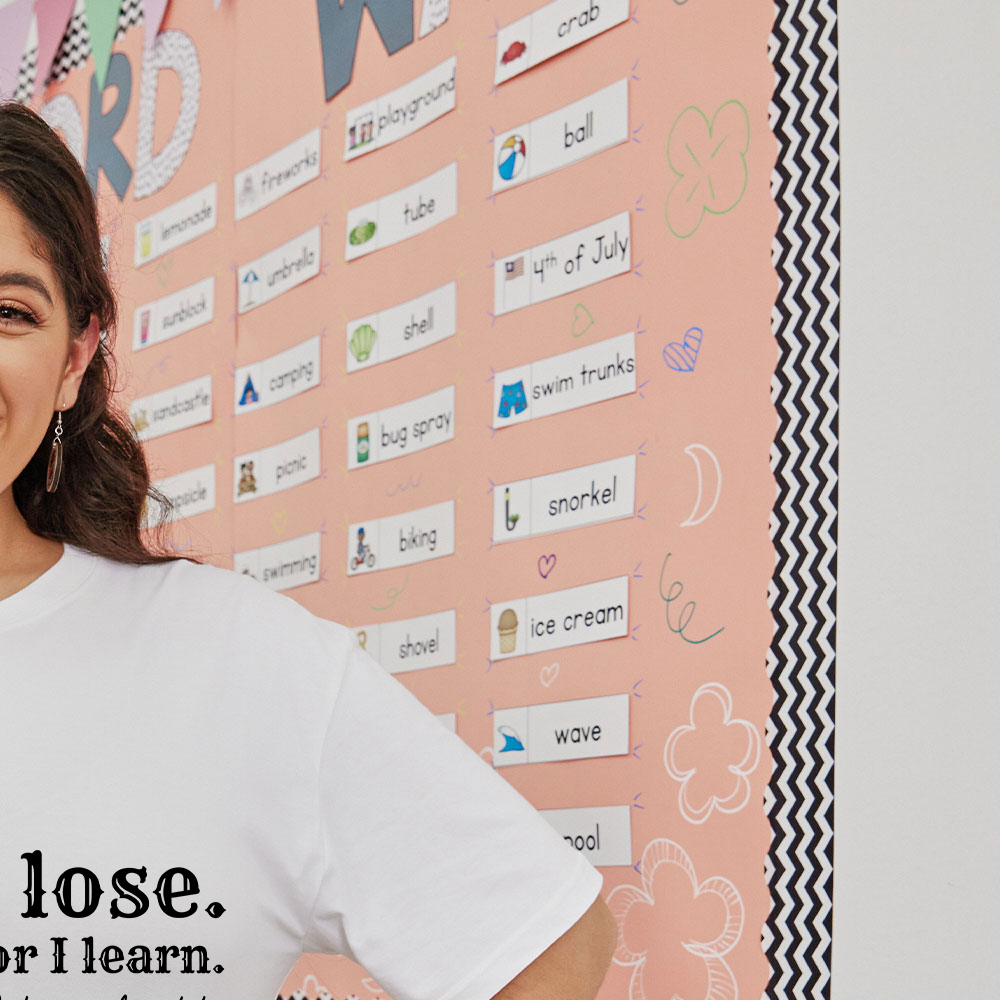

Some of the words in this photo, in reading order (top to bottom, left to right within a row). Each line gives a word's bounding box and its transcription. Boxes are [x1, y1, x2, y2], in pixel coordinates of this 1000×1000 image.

[557, 0, 600, 38] crab
[377, 66, 457, 136] playground
[564, 110, 593, 149] ball
[261, 148, 318, 192] fireworks
[161, 200, 213, 241] lemonade
[403, 195, 436, 225] tube
[267, 246, 315, 287] umbrella
[533, 252, 557, 283] 4th
[564, 244, 586, 275] of
[592, 230, 629, 263] July
[403, 306, 434, 341] shell
[268, 361, 314, 393] camping
[532, 376, 574, 400] swim
[580, 352, 635, 387] trunks
[381, 424, 408, 449] bug
[412, 411, 452, 442] spray
[276, 454, 308, 484] picnic
[548, 475, 617, 517] snorkel
[400, 526, 437, 552] biking
[262, 554, 317, 583] swimming
[531, 618, 556, 638] ice
[563, 603, 624, 631] cream
[399, 627, 440, 659] shovel
[554, 724, 602, 745] wave
[21, 850, 226, 919] lose.
[50, 937, 68, 973] I
[82, 936, 224, 973] learn.
